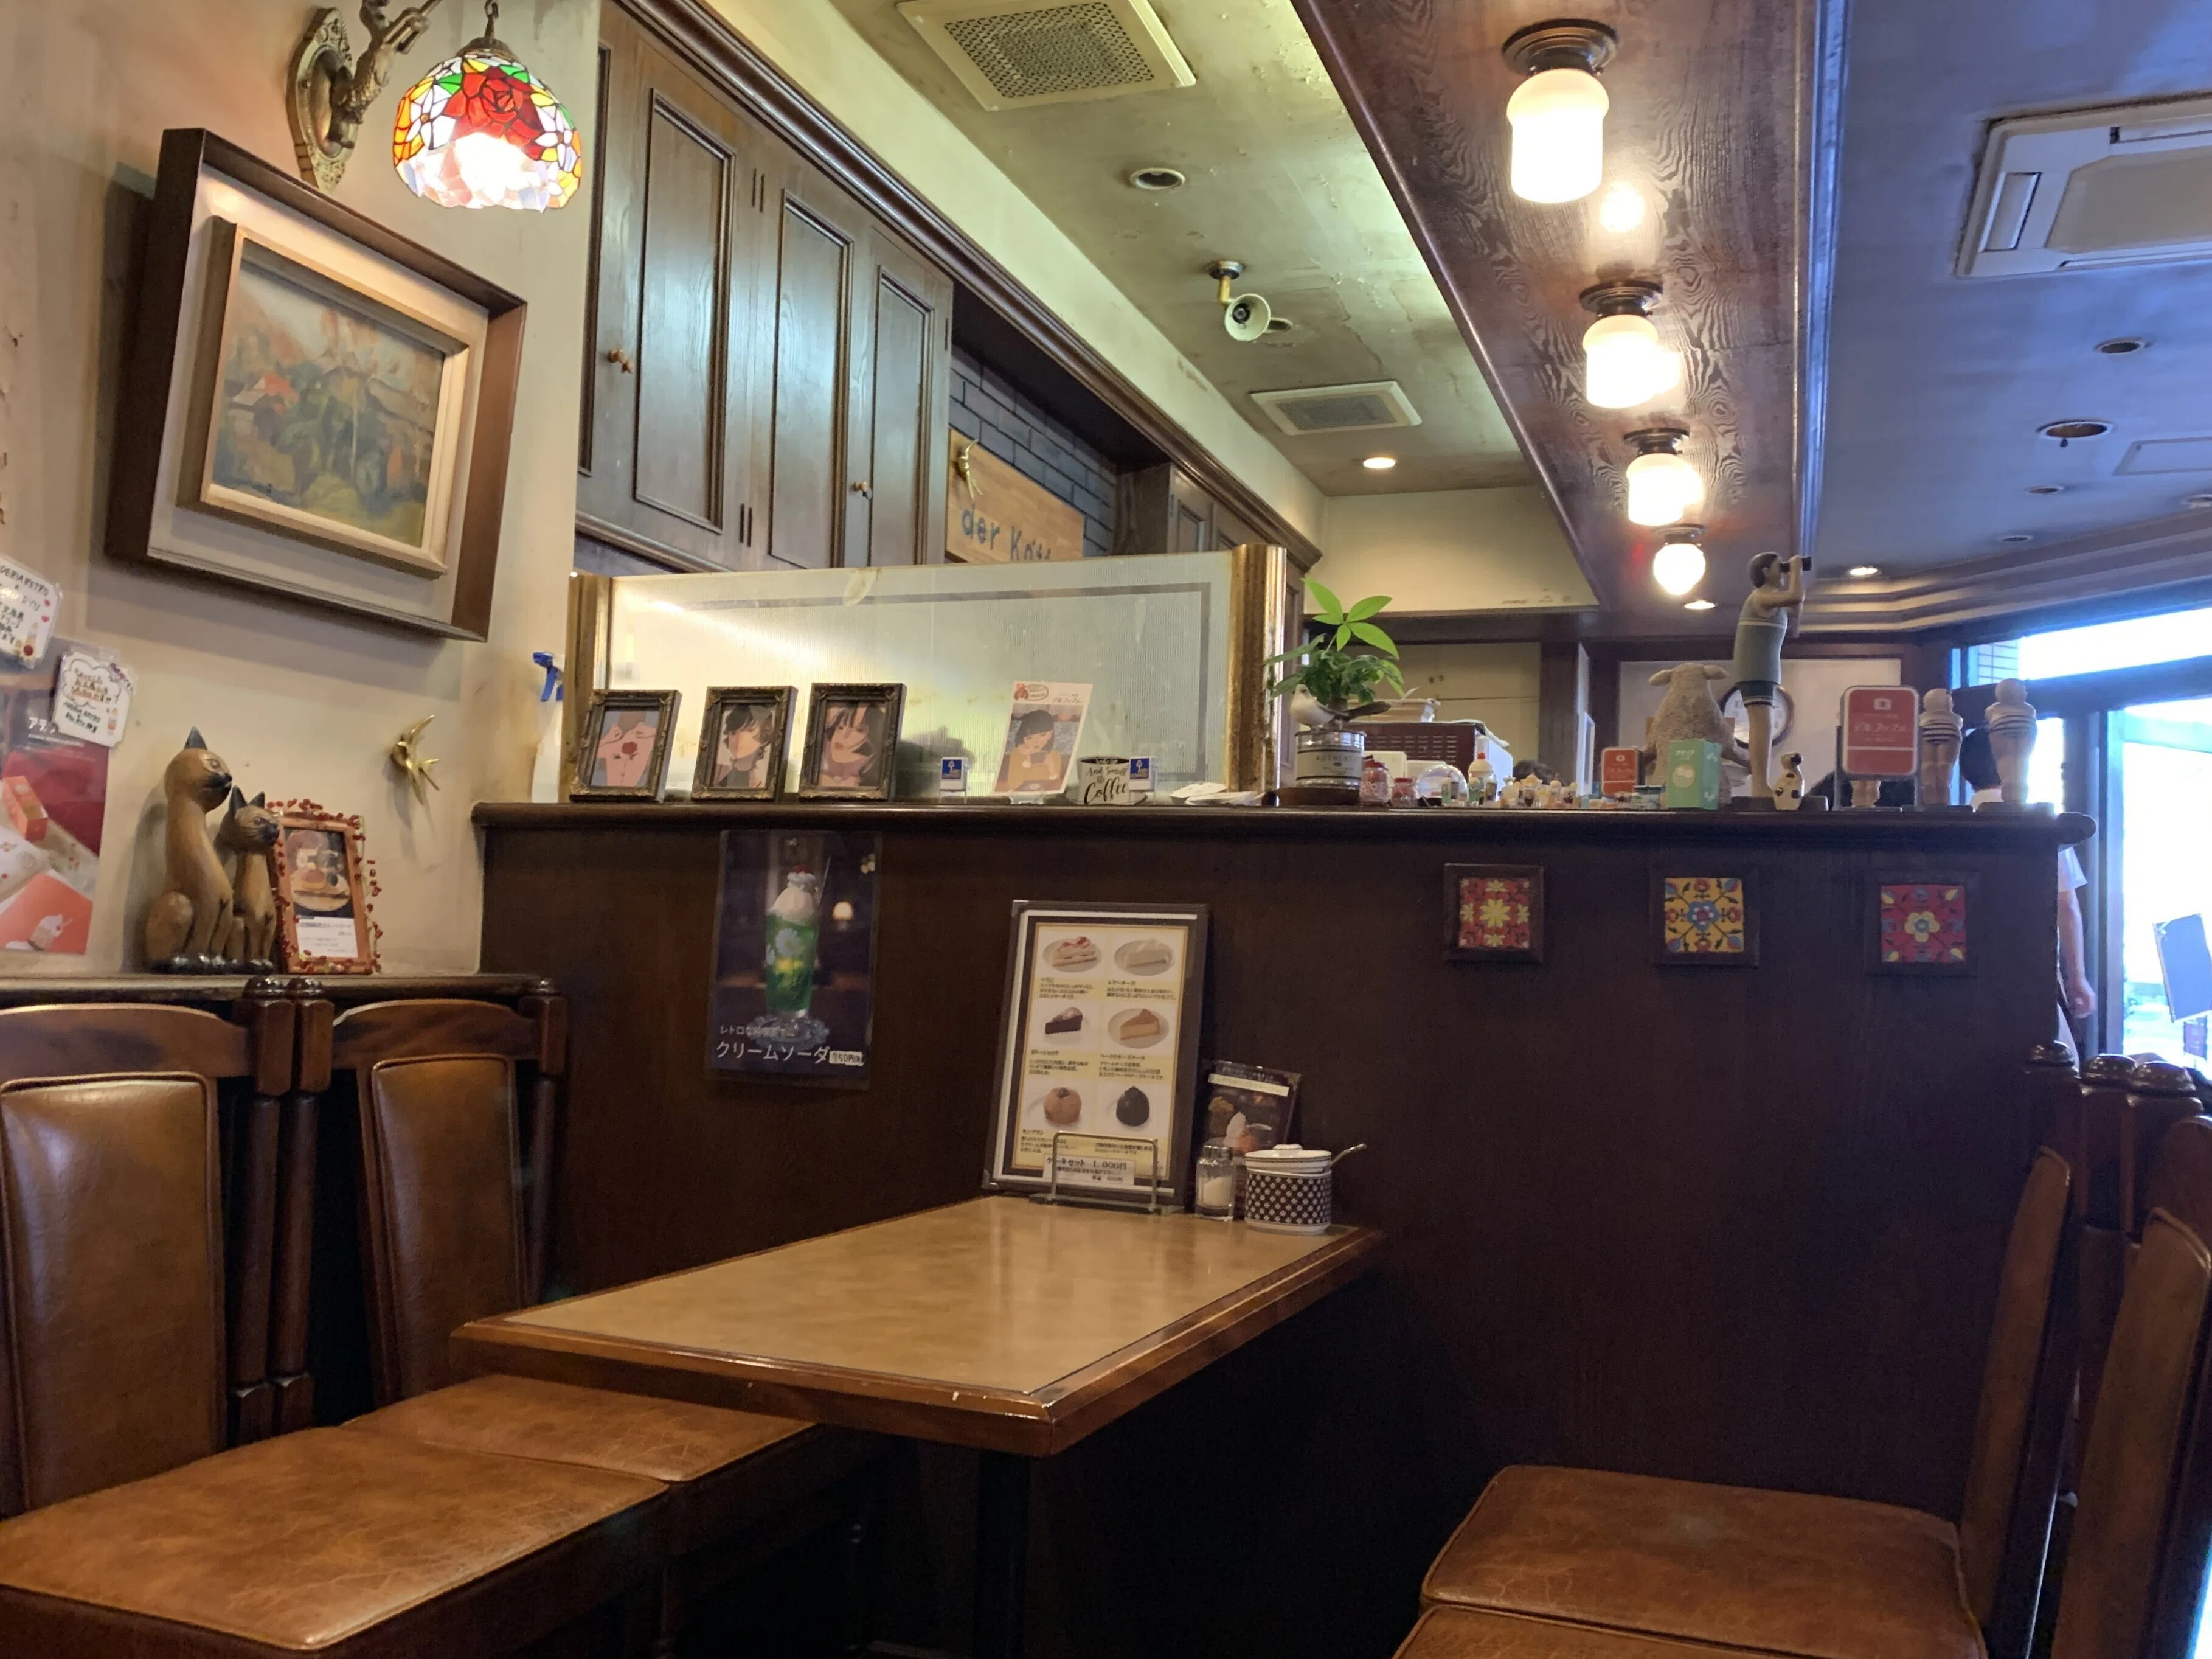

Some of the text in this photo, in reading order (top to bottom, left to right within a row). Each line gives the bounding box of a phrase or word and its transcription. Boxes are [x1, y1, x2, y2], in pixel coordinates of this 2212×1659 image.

[962, 503, 1000, 550] der
[1084, 776, 1127, 804] Coffee
[716, 1040, 831, 1064] クリームソーダ
